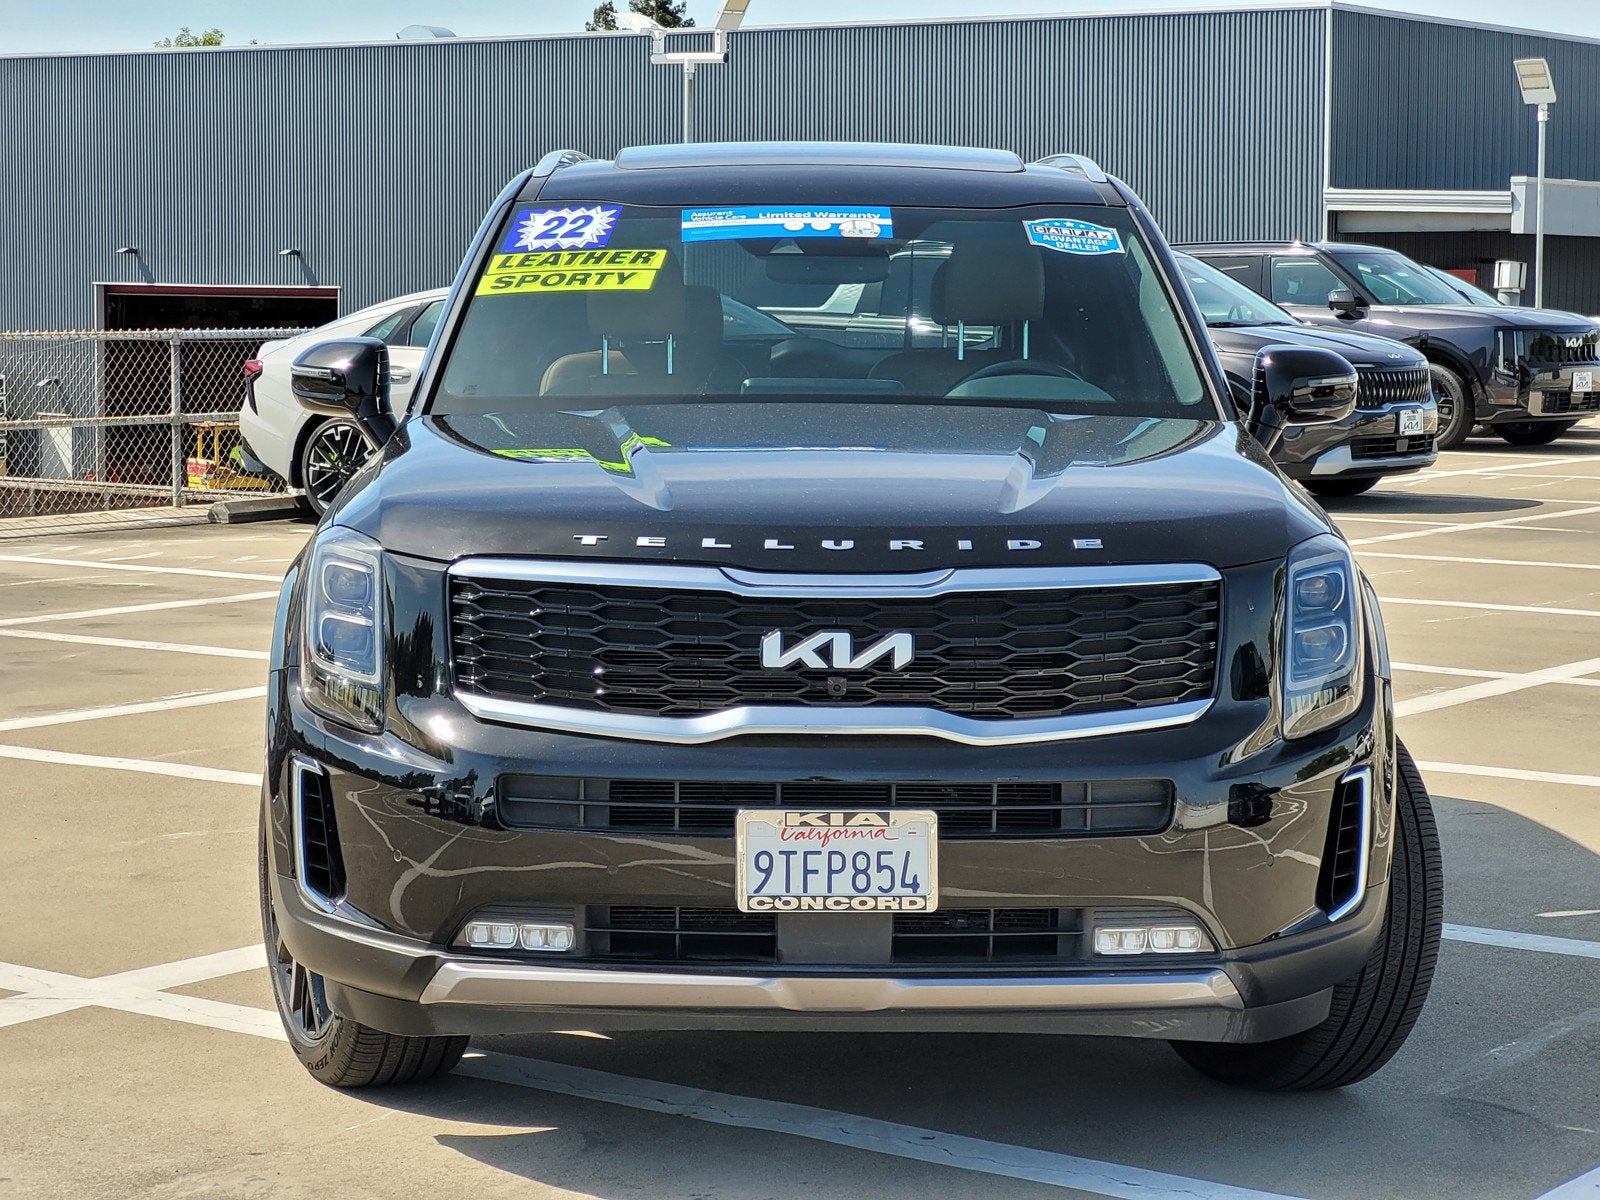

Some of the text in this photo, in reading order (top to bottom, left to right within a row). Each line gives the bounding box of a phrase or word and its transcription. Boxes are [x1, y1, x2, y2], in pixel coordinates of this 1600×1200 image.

[758, 211, 881, 219] Limited Warranty
[533, 214, 595, 240] 22
[1032, 225, 1113, 241] CARFAX
[1043, 234, 1109, 247] ADVANTAGE
[1055, 241, 1100, 252] DEALER
[496, 250, 660, 270] LEATHER
[490, 271, 636, 290] SPORTY
[573, 534, 1104, 551] TELLURIDE
[761, 629, 915, 671] KIA
[786, 812, 890, 827] KIA
[780, 827, 899, 848] California
[752, 850, 921, 895] 9TFP854
[749, 896, 926, 911] CONCORD
